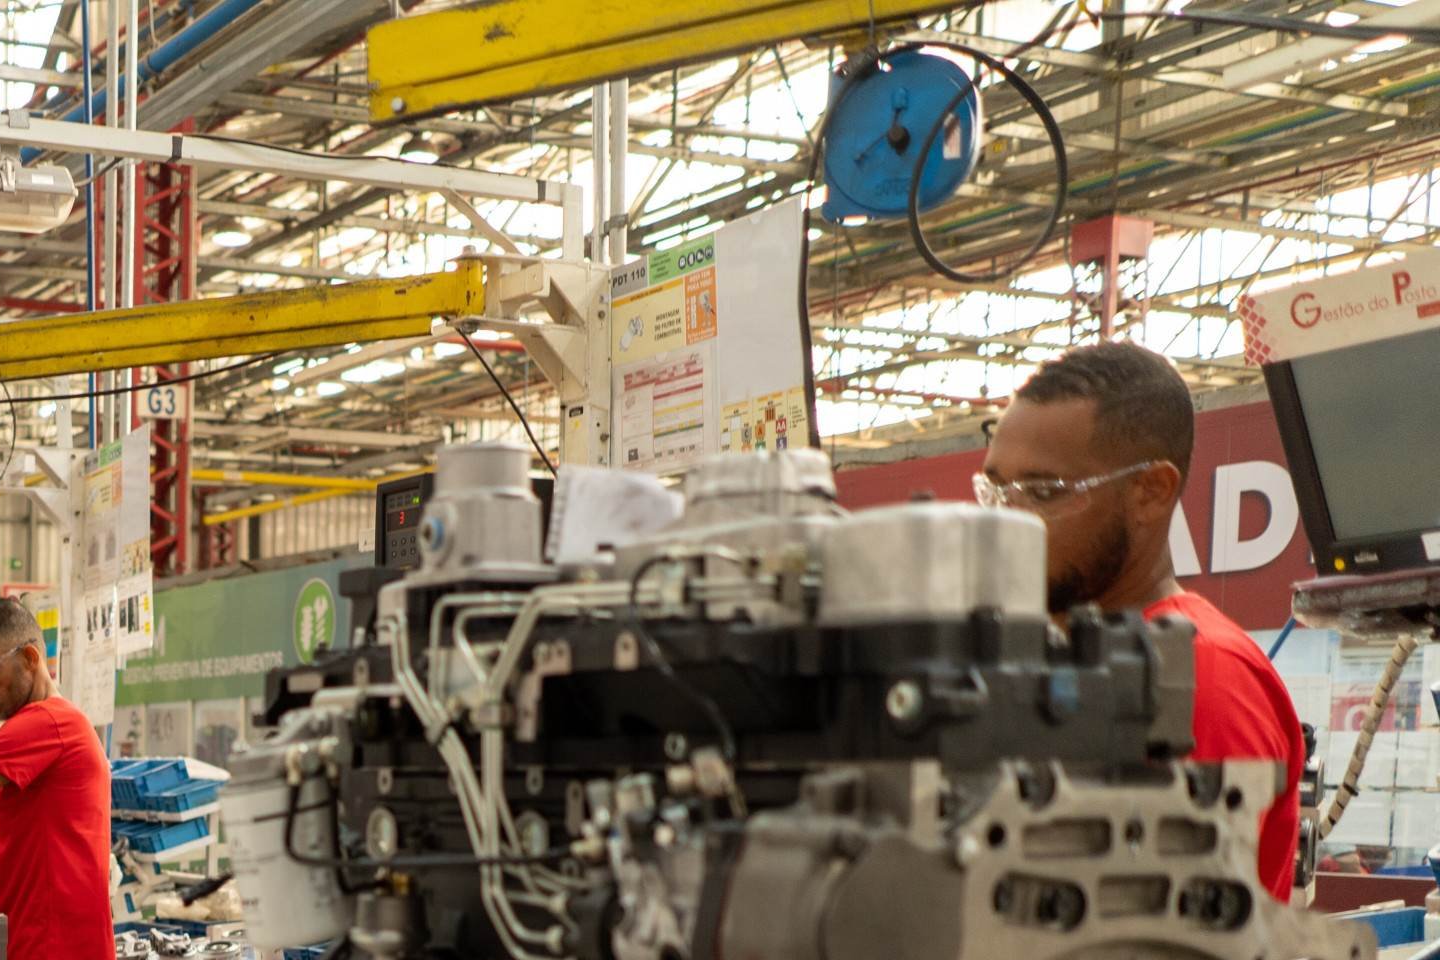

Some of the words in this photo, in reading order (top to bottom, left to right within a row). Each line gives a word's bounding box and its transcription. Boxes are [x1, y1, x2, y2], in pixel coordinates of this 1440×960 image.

[612, 274, 628, 288] PDT
[631, 267, 646, 281] 110
[1290, 291, 1364, 330] Gestão
[147, 386, 176, 416] G3
